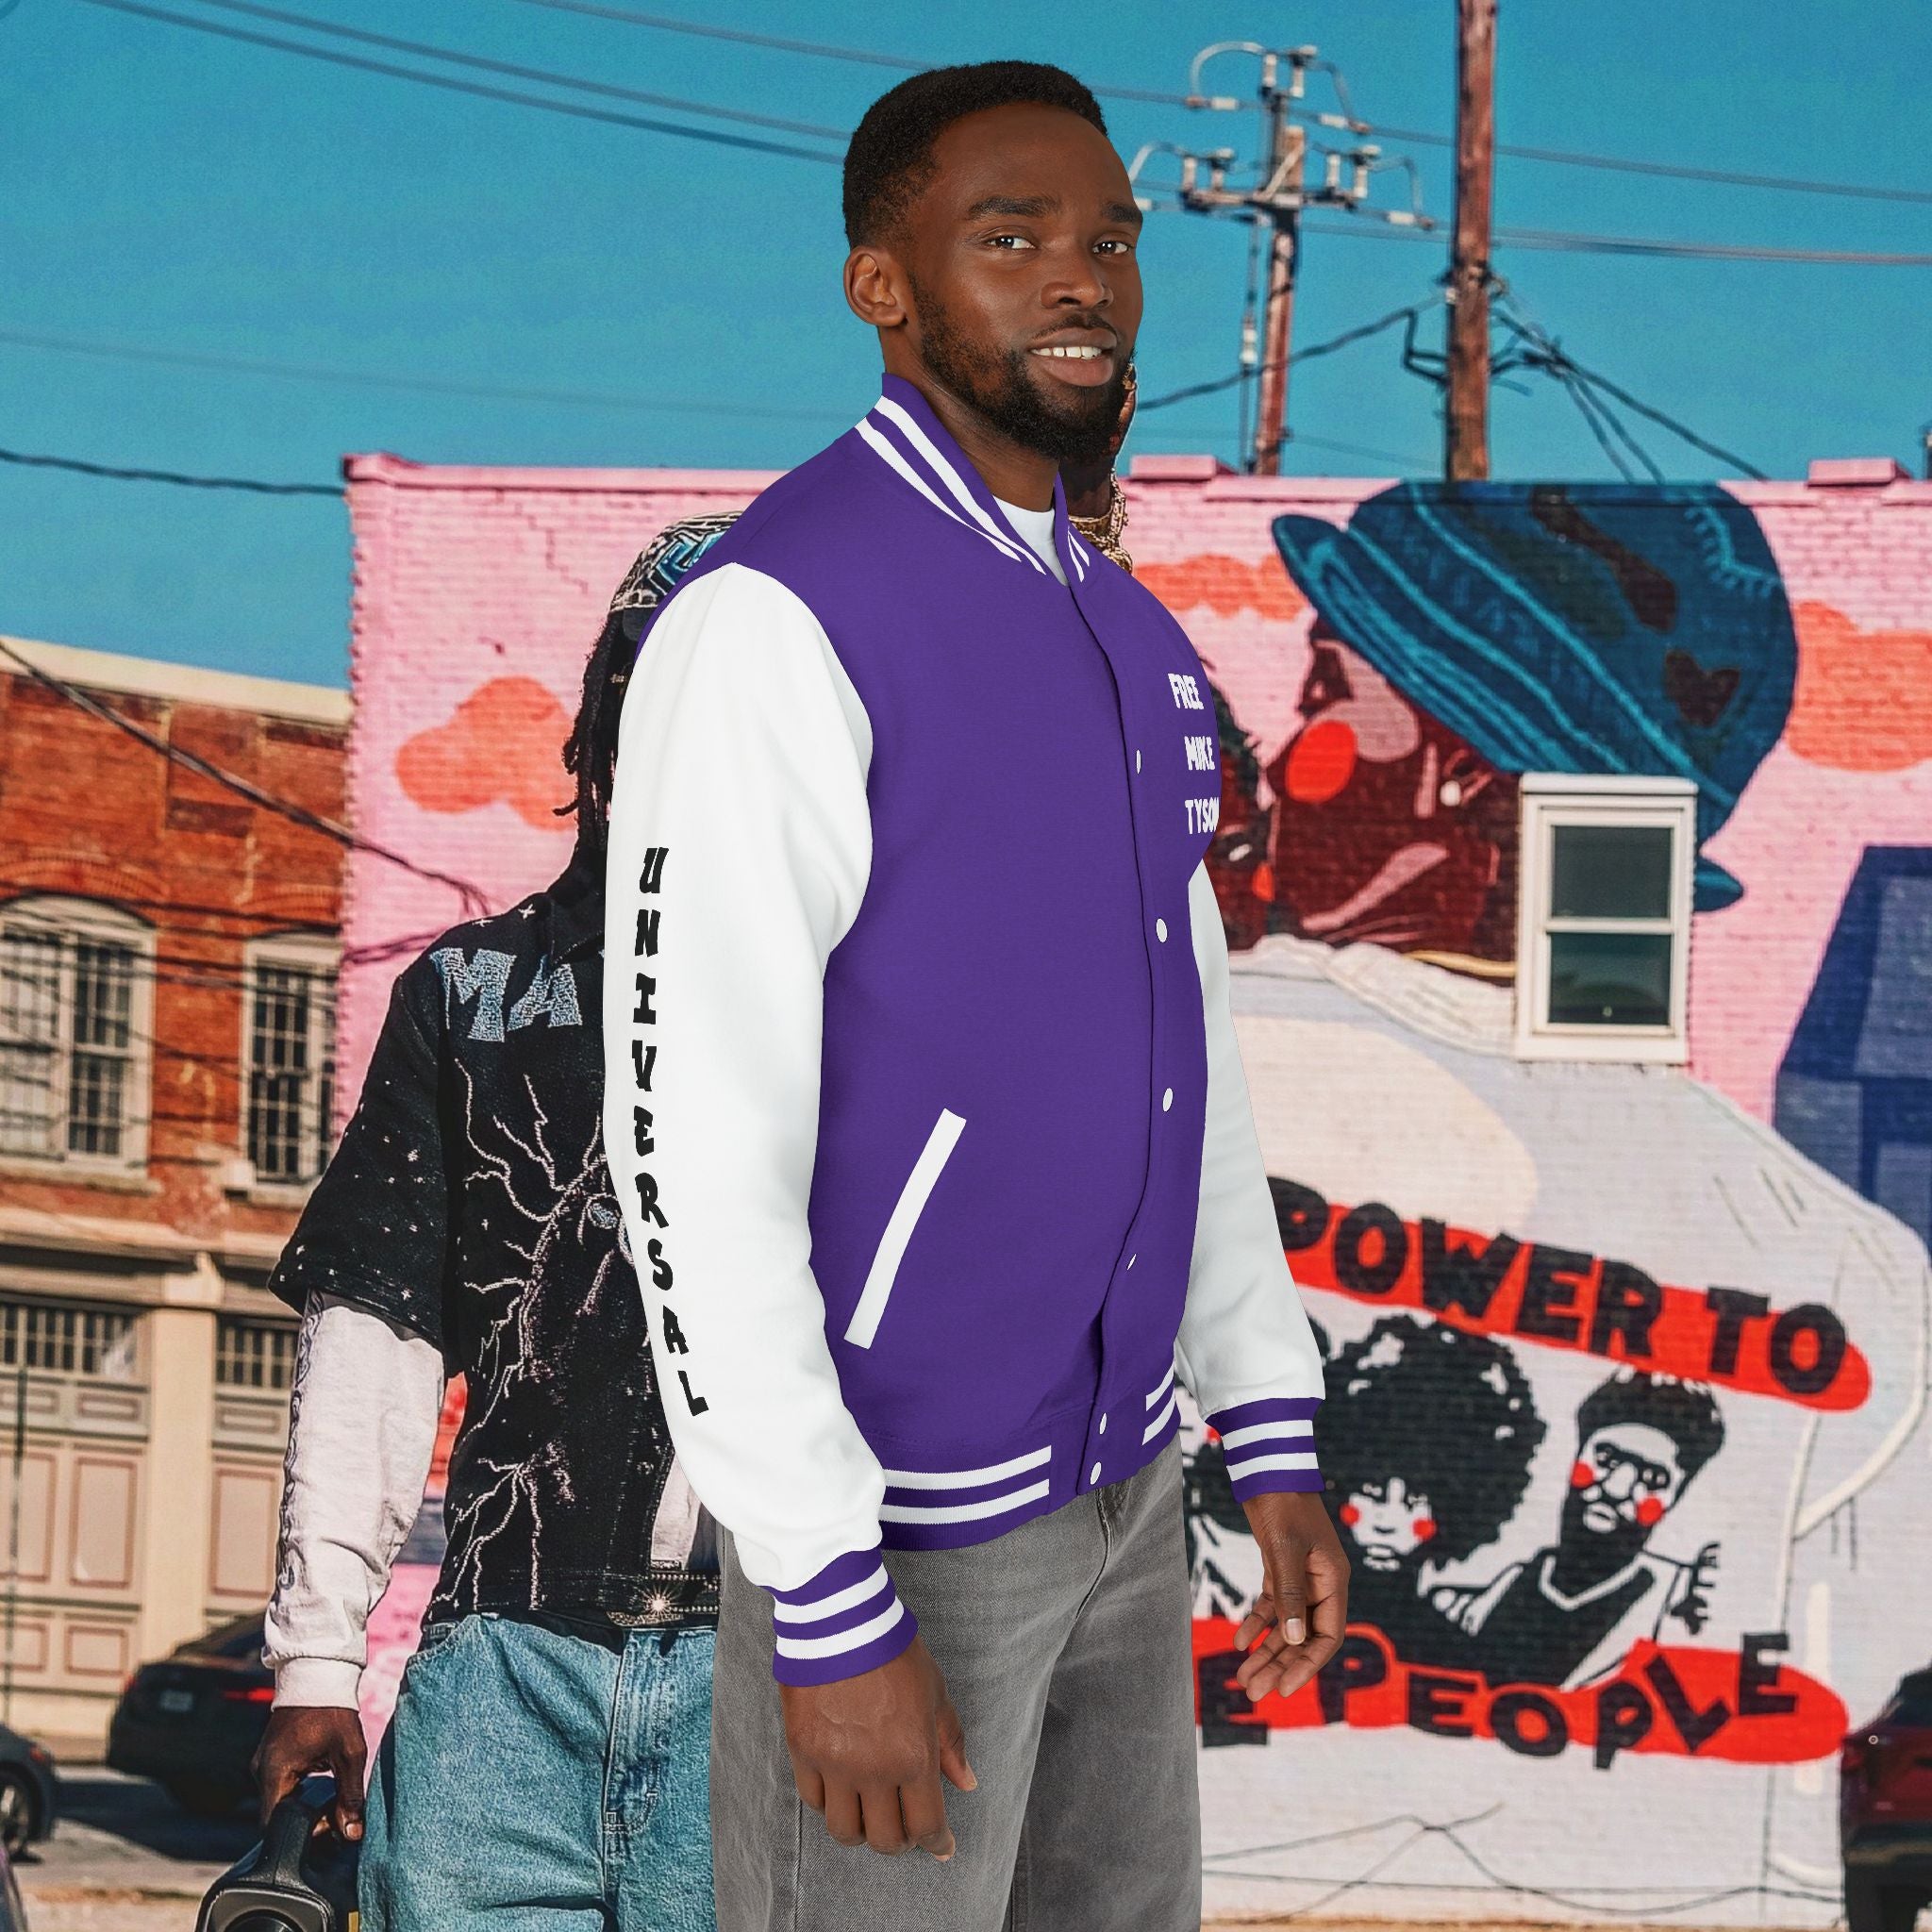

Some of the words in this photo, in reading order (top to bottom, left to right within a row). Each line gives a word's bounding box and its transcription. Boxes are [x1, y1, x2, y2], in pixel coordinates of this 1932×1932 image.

[1168, 673, 1204, 709] FREE
[1184, 736, 1215, 771] MIKE
[429, 946, 605, 1043] MA
[632, 846, 709, 1417] UNIVERSAL
[1266, 1175, 1662, 1357] POWER
[1707, 1287, 1846, 1393] TO
[1321, 1632, 1796, 1770] PEOPLE
